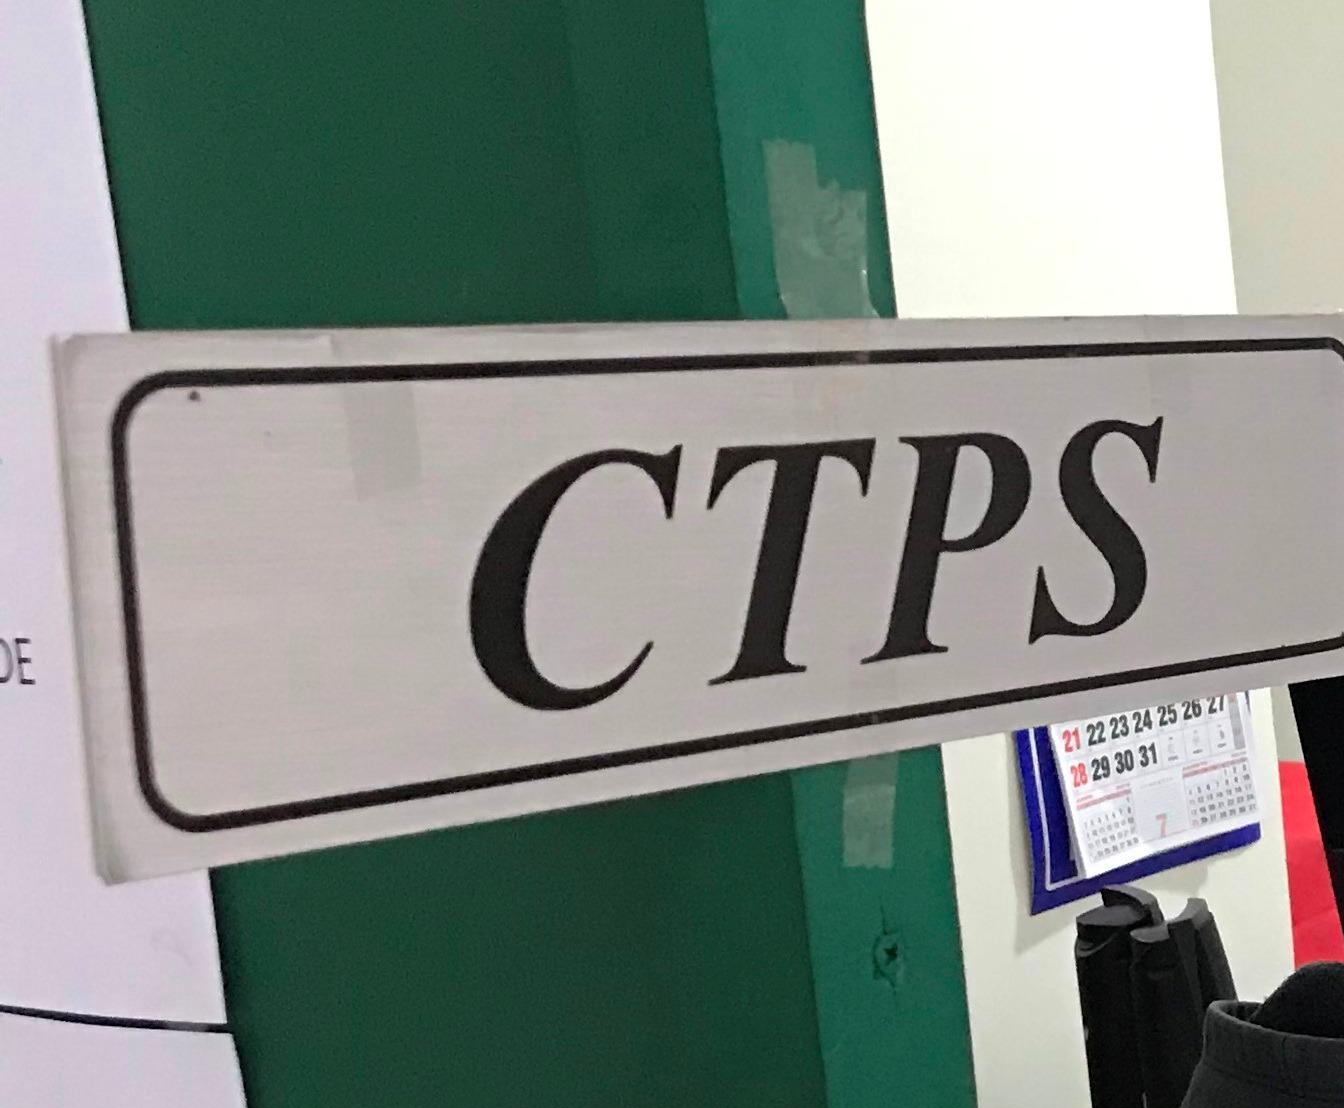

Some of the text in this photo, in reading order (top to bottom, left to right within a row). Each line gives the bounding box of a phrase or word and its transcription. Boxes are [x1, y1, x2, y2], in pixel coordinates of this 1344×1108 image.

[470, 416, 1164, 711] CTPS
[1063, 727, 1081, 752] 21
[1086, 721, 1106, 746] 22
[1109, 714, 1129, 739] 23
[1132, 709, 1152, 733] 24
[1157, 704, 1177, 727] 25
[1182, 698, 1202, 720] 26
[1070, 742, 1158, 788] 28 29 30 31
